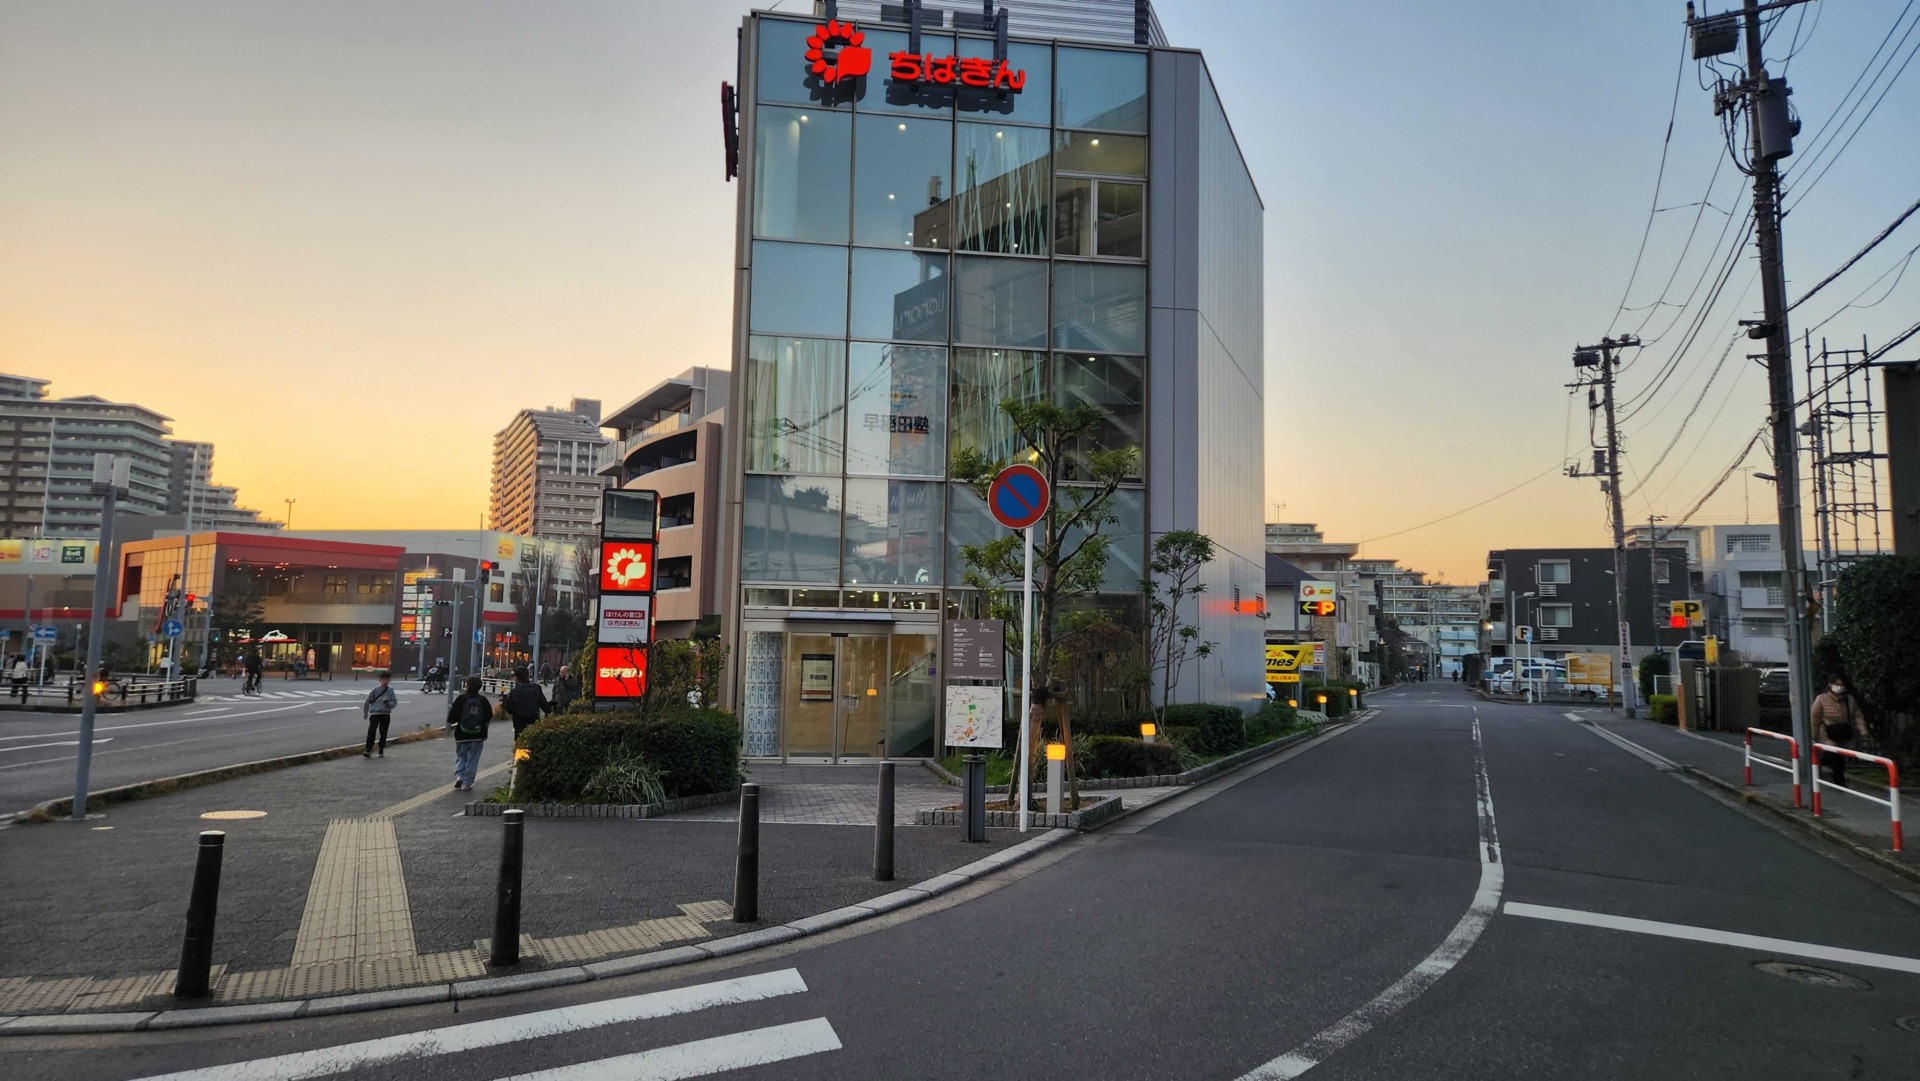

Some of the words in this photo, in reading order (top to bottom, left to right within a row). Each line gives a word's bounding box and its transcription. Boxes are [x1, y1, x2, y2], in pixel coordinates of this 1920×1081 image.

[889, 50, 1026, 90] ちばぎん
[863, 413, 930, 434] 早稲田塾
[1321, 601, 1335, 615] P
[1685, 603, 1700, 618] P
